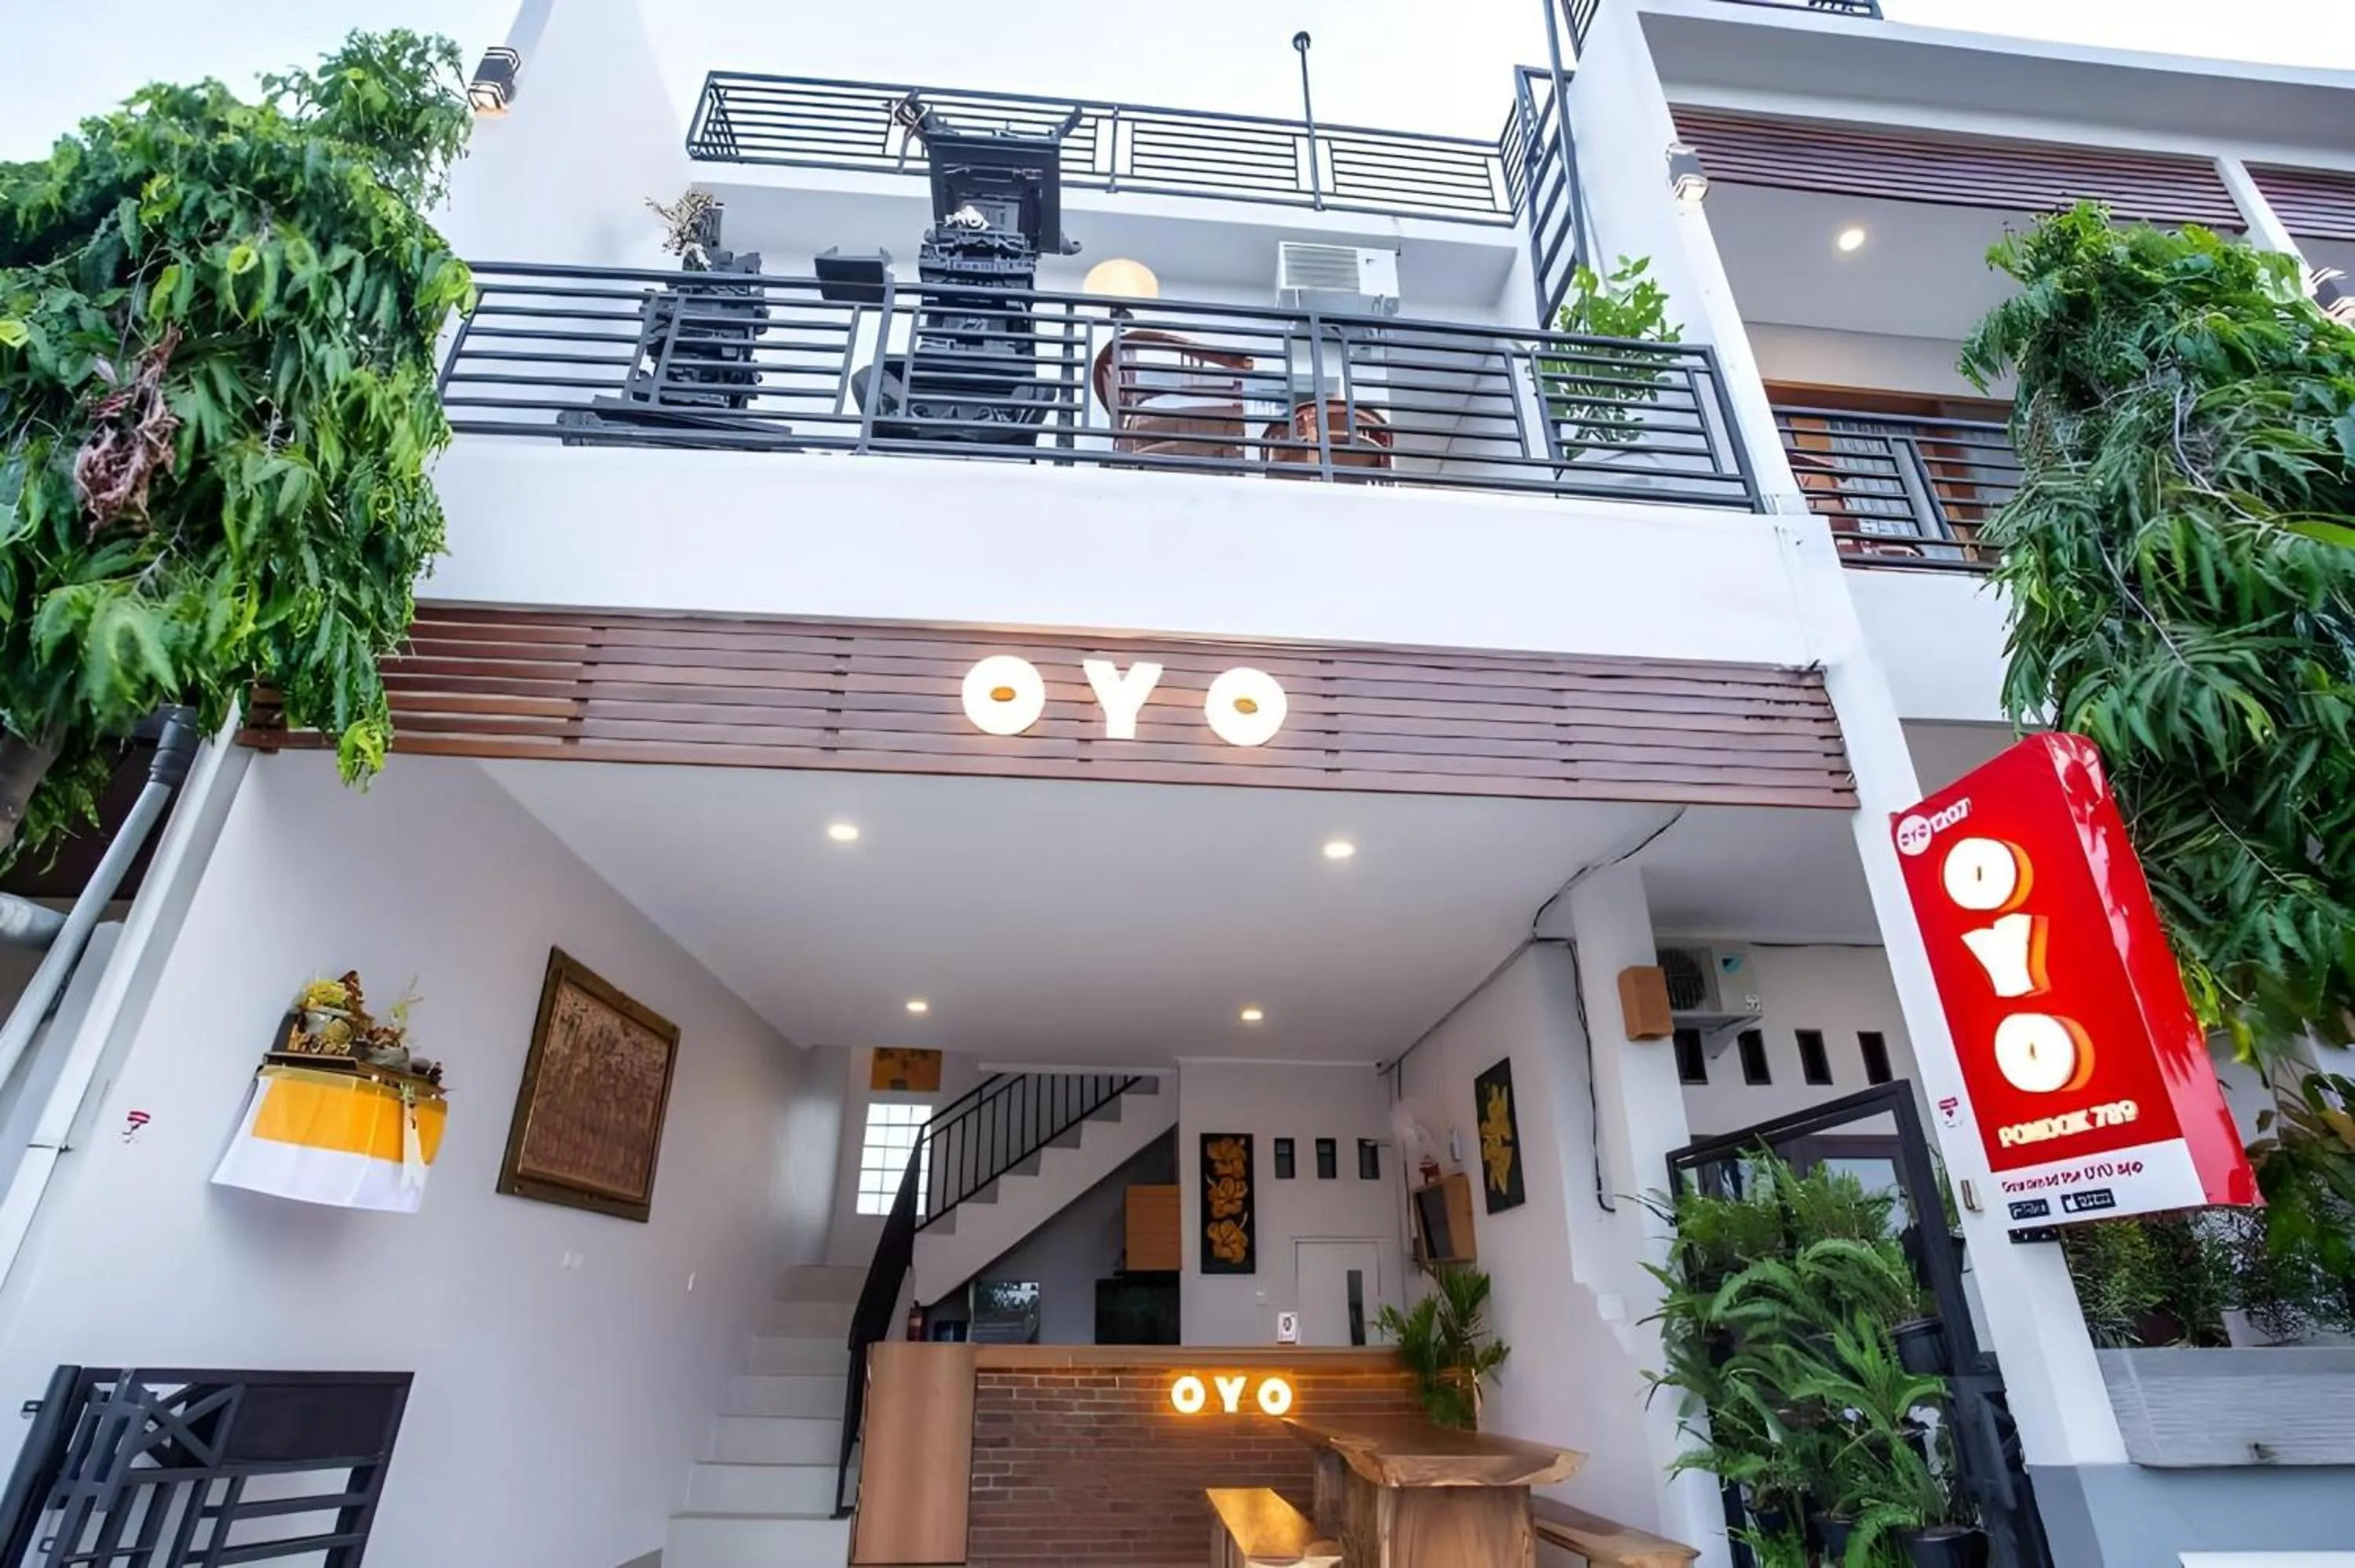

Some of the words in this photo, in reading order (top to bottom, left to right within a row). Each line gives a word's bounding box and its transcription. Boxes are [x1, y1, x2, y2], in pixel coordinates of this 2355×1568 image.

[962, 655, 1288, 747] OYO
[1943, 837, 2094, 1093] OYO
[1171, 1375, 1293, 1416] OYO
